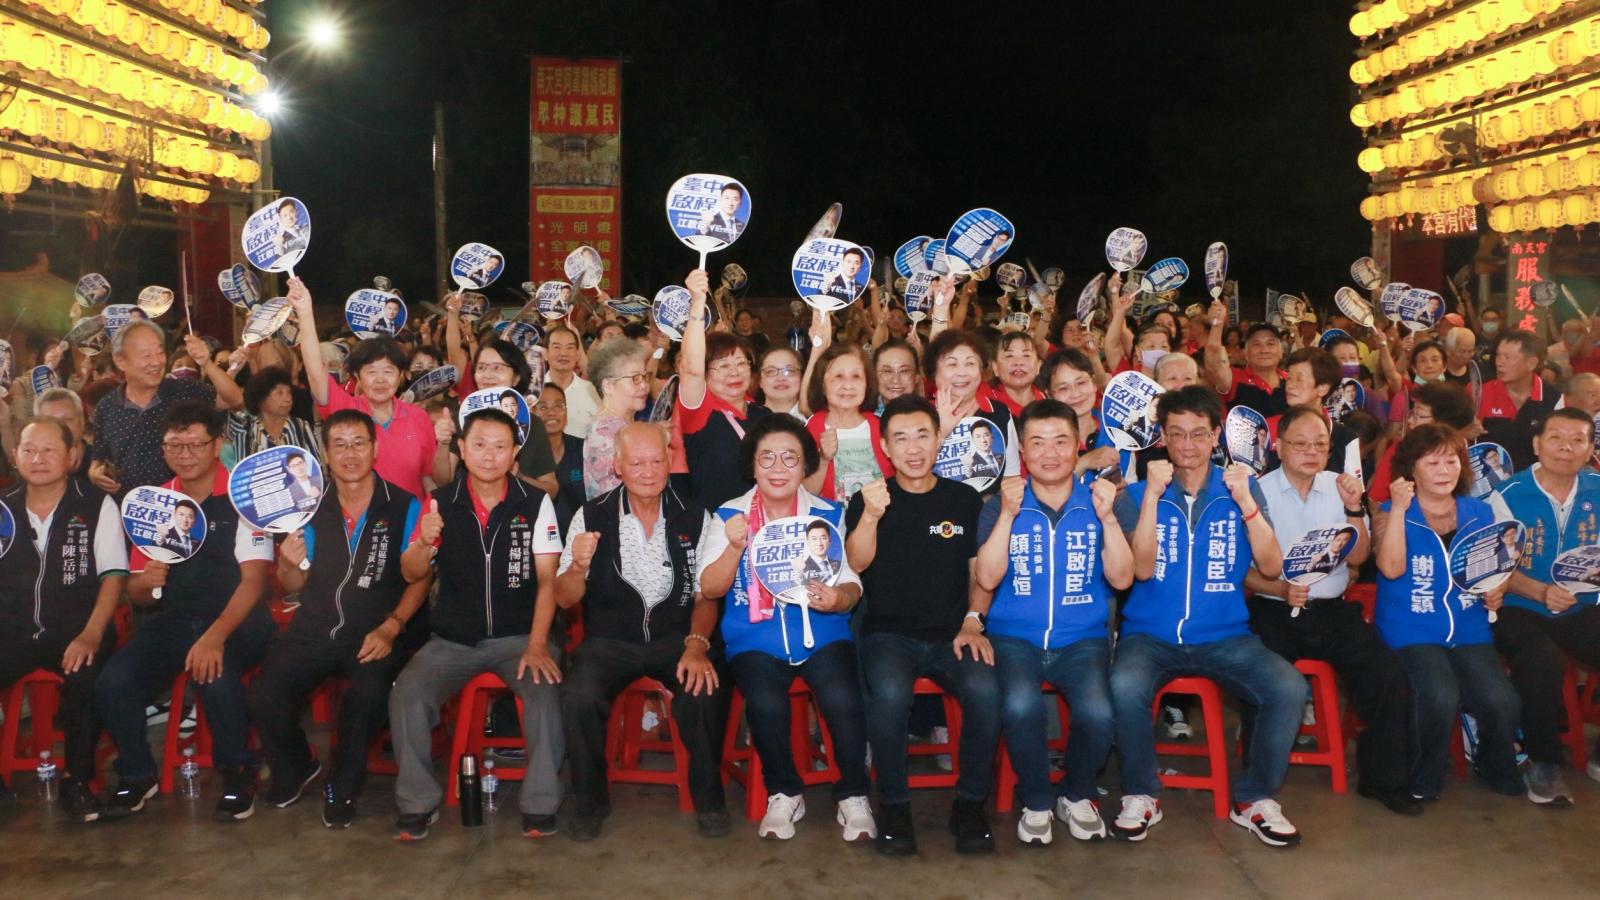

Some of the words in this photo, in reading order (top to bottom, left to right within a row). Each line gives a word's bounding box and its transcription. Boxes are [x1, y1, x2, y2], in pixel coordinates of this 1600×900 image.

[683, 178, 724, 193] 臺中
[671, 194, 718, 210] 啟程
[808, 241, 847, 256] 臺中
[796, 256, 840, 272] 啟程
[1123, 373, 1158, 397] 臺中
[467, 393, 501, 410] 臺中
[1109, 384, 1147, 411] 啟程
[136, 488, 178, 507] 臺中
[126, 504, 172, 524] 啟程
[764, 522, 807, 541] 臺中
[756, 542, 805, 563] 啟程
[1033, 534, 1043, 575] 立法委員
[1208, 520, 1227, 579] 江啟臣
[1066, 531, 1087, 593] 江啟臣
